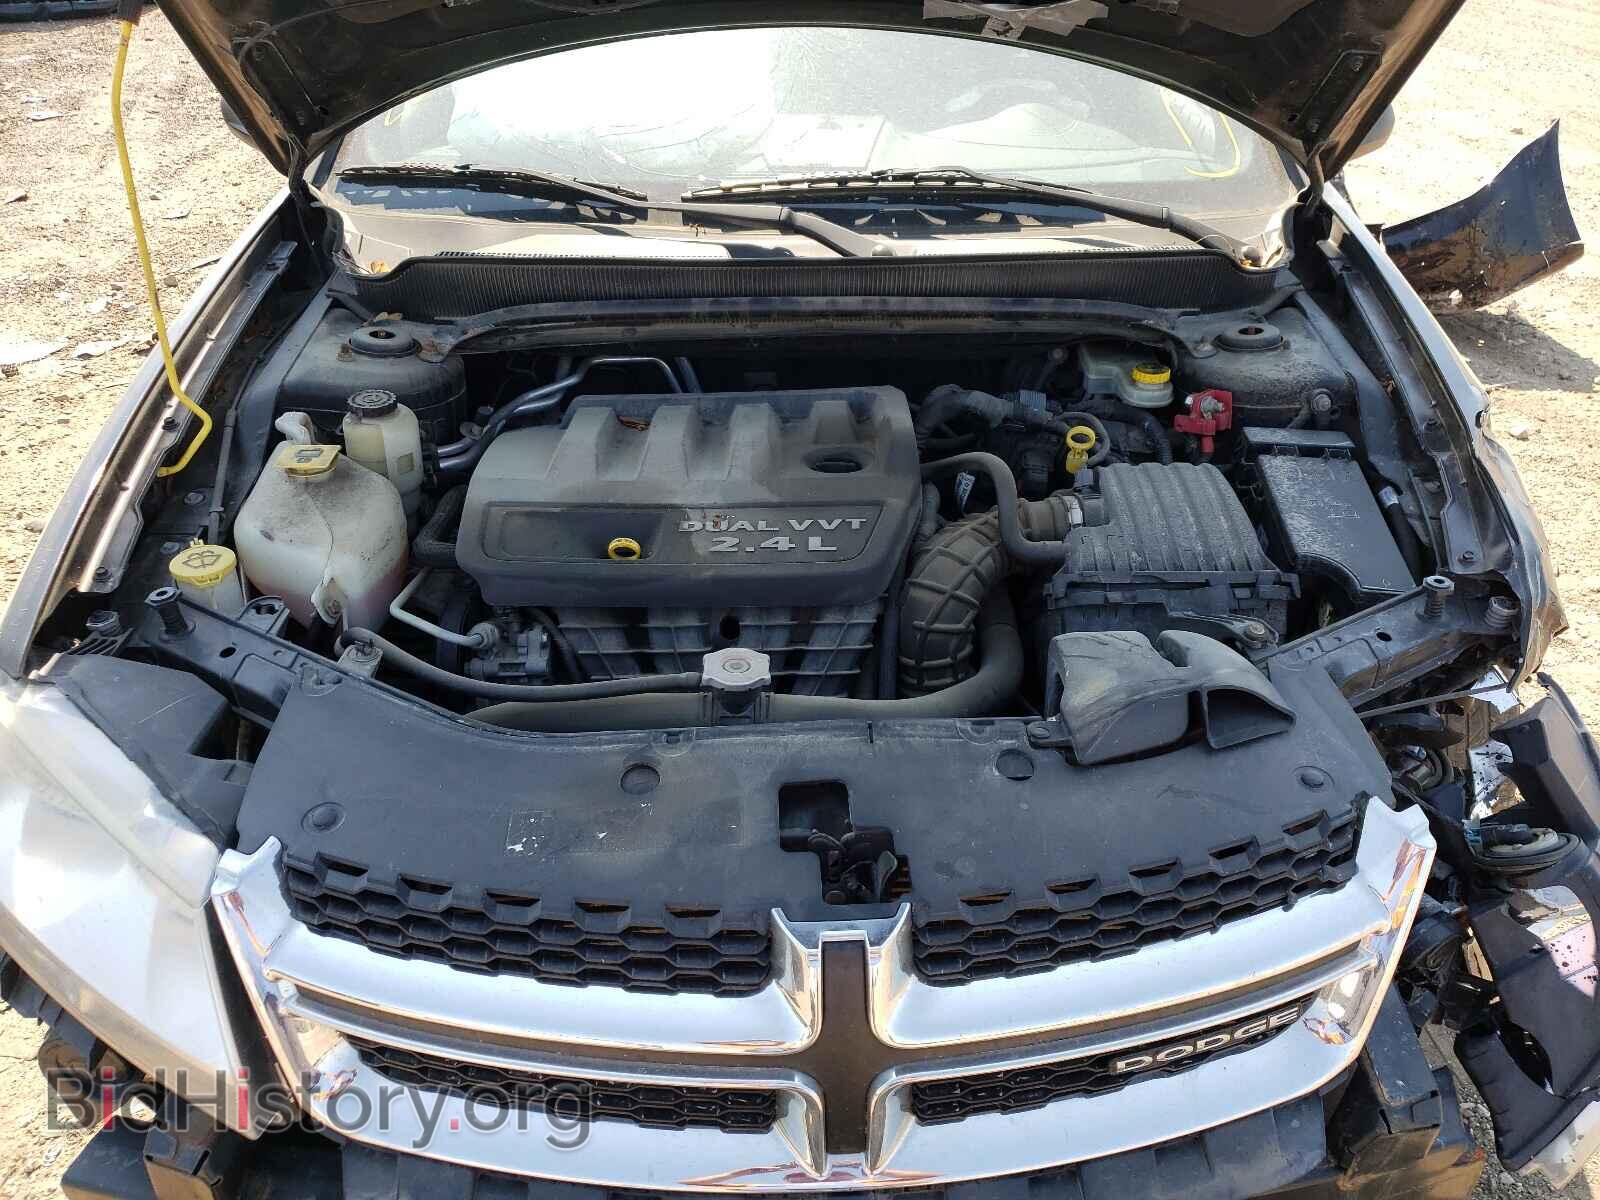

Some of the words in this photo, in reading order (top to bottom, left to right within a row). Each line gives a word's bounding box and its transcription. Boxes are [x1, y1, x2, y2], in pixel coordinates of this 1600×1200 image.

[678, 519, 780, 533] DUAL
[787, 518, 867, 531] VVT
[1115, 1005, 1300, 1074] DODGE
